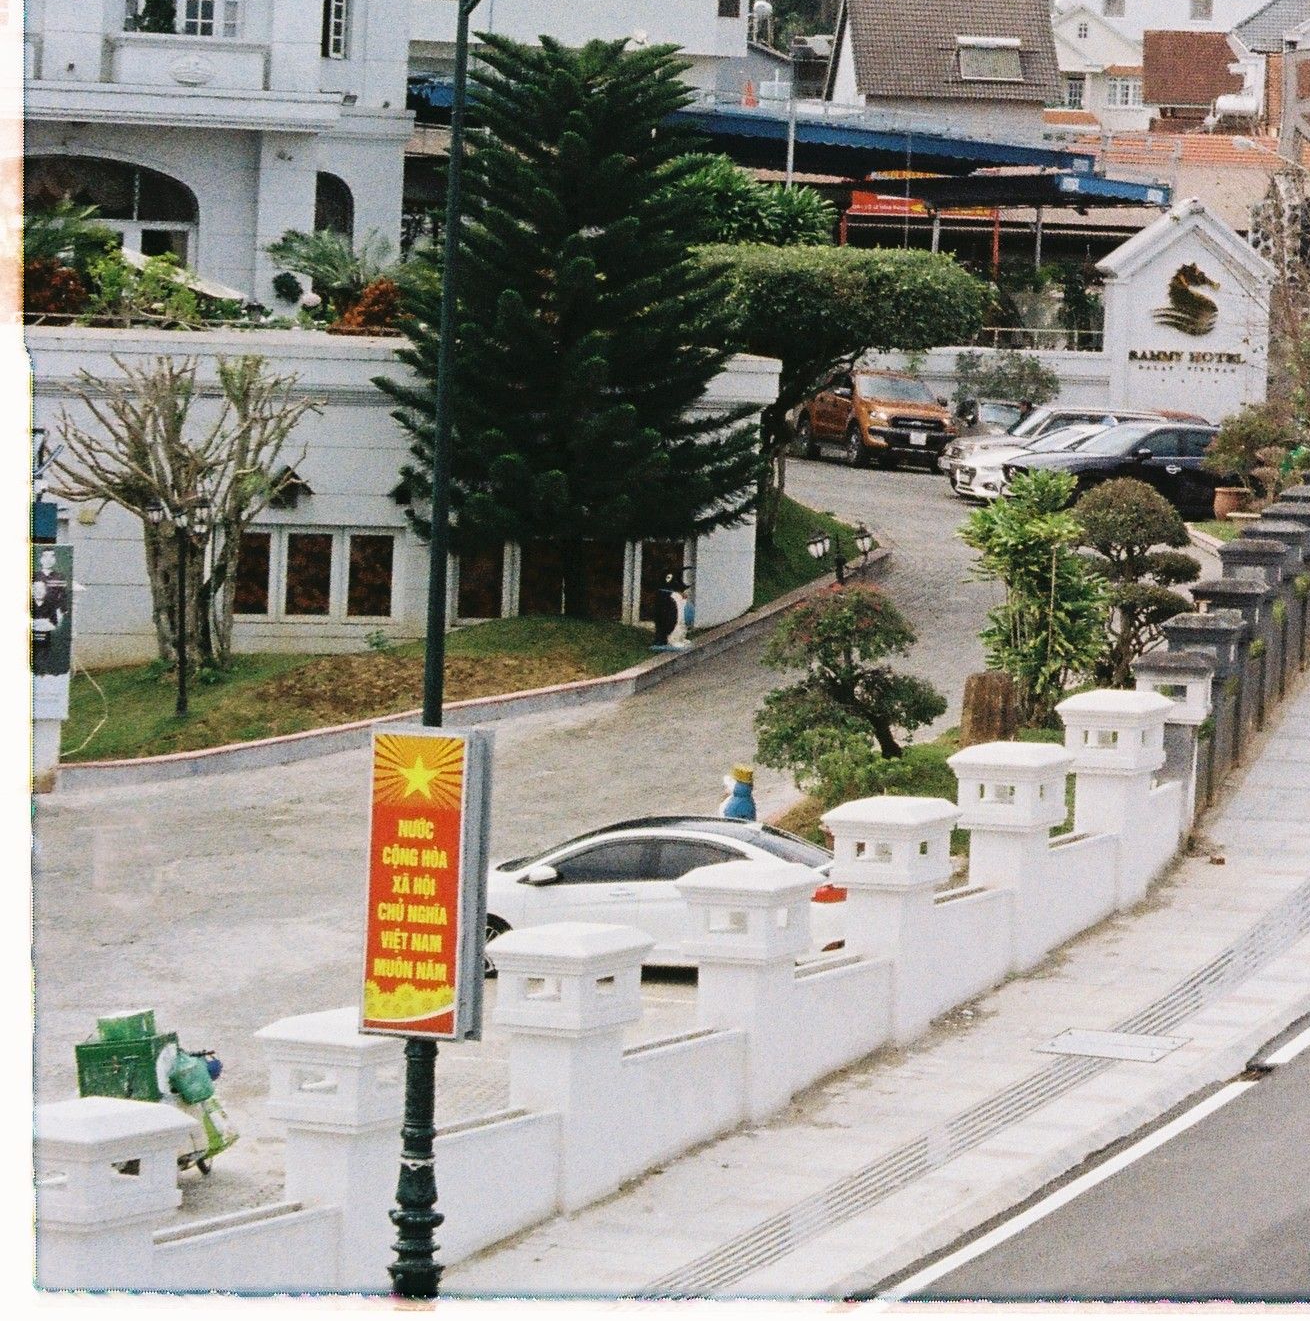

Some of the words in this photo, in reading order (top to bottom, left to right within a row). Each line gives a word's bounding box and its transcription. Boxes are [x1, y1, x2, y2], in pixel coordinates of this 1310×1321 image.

[1189, 351, 1246, 365] HOTEL
[398, 817, 434, 840] NƯỚC
[382, 844, 419, 869] CỘNG
[392, 873, 410, 894] XÃ
[413, 874, 436, 899] HỘI
[377, 897, 405, 922] CHỦ
[407, 903, 448, 926] NGHĨA
[381, 928, 409, 953] VIỆT
[410, 932, 443, 953] NAM
[373, 956, 414, 979] MUÔN
[416, 959, 447, 981] NĂM
